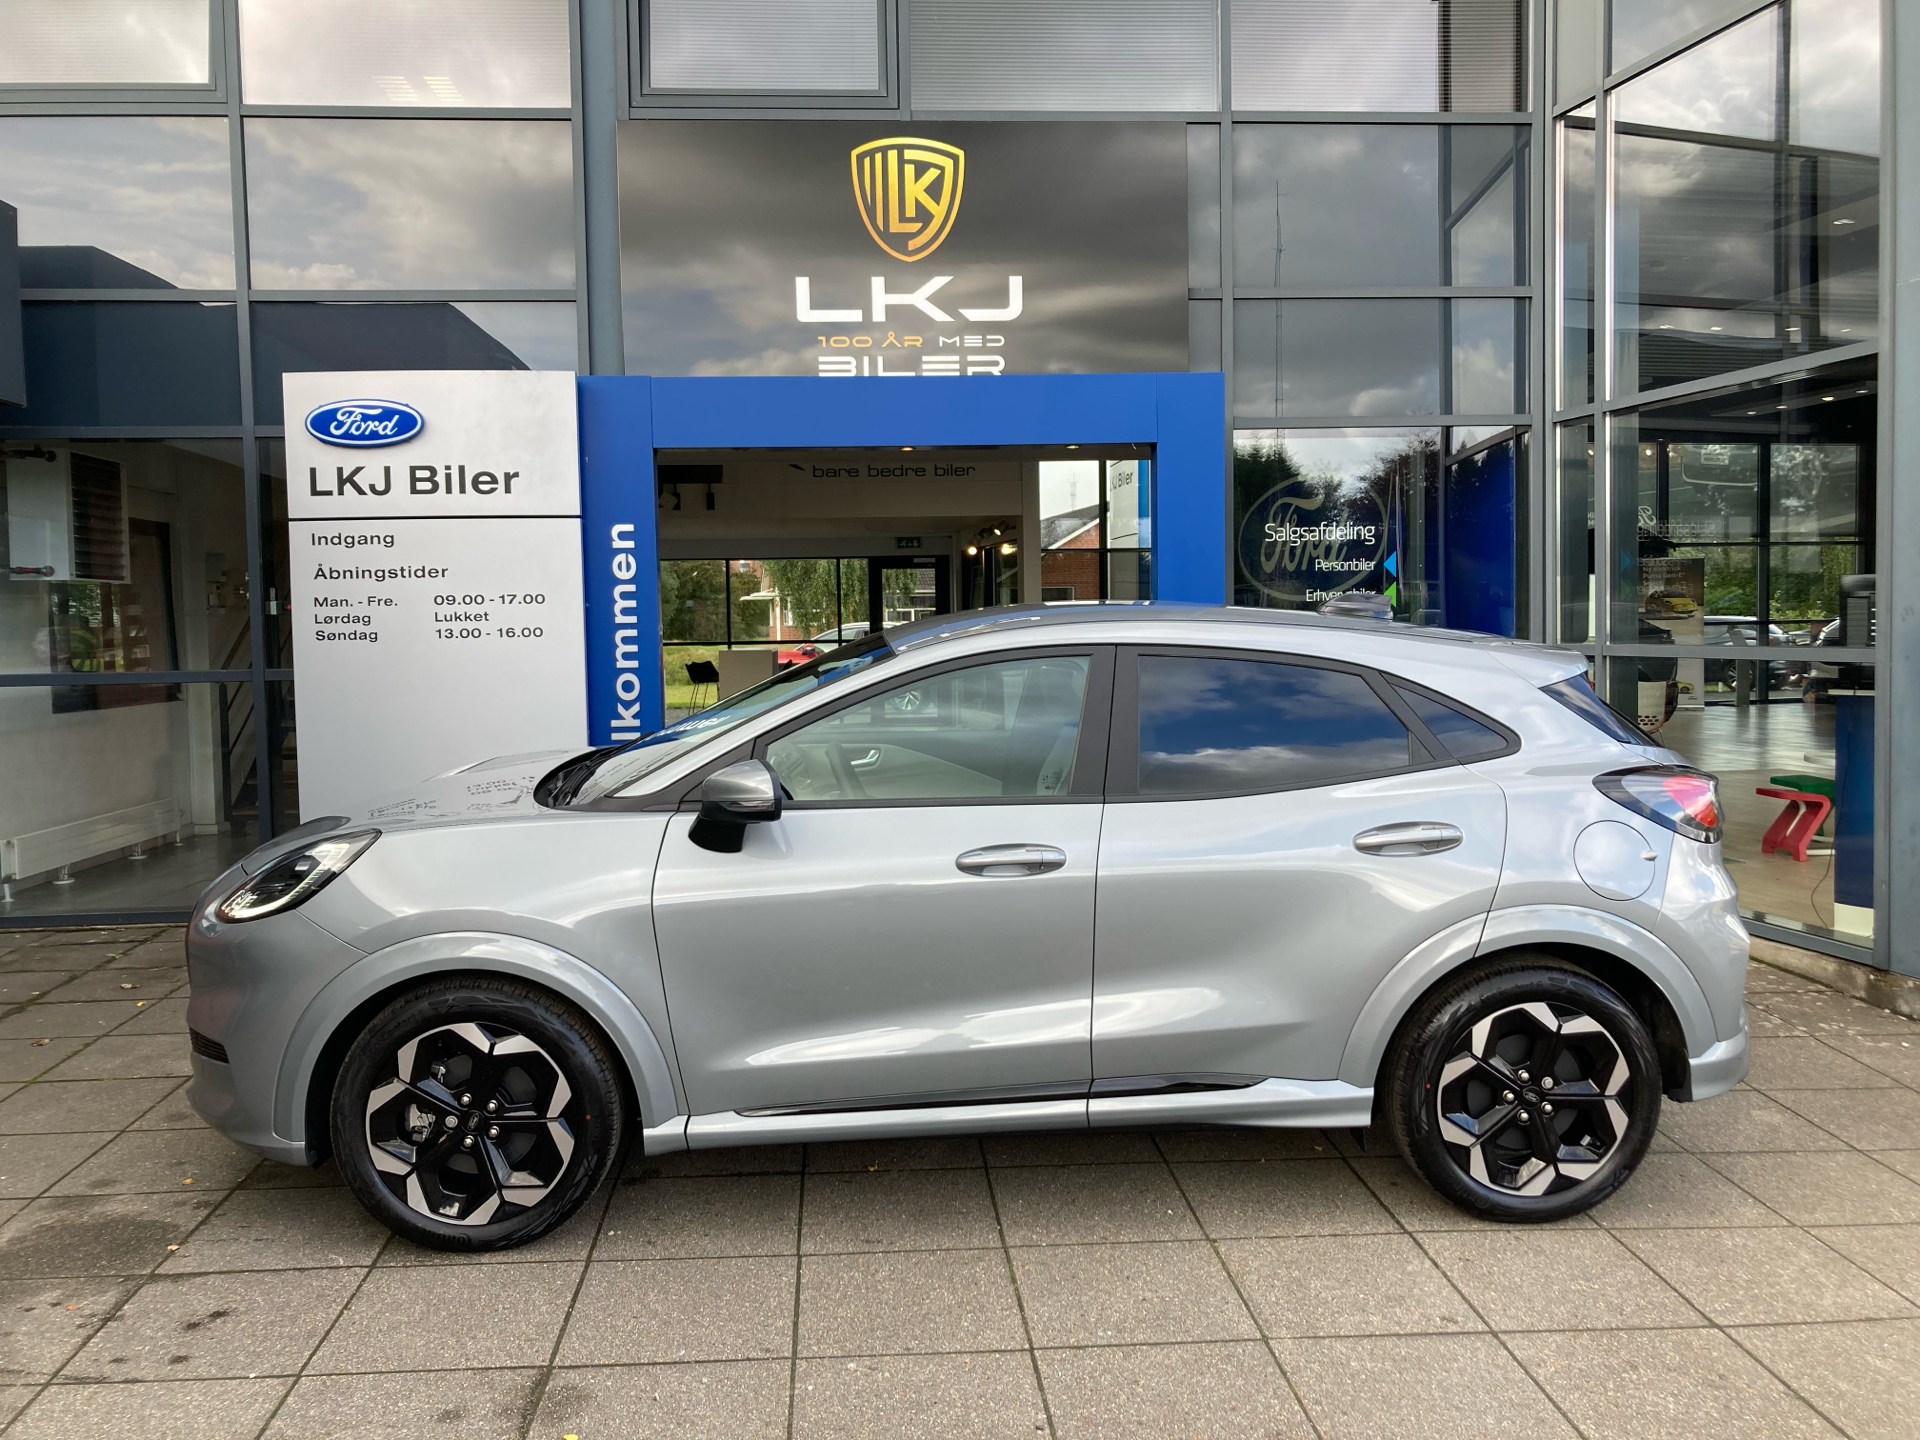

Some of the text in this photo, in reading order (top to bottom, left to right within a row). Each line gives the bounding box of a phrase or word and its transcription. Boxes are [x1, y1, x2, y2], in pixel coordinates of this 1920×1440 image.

[795, 275, 1023, 323] LKJ
[817, 331, 1005, 348] 100 ÅR MED
[818, 355, 1006, 377] BILER
[329, 406, 400, 437] Ford
[812, 463, 976, 478] bare bedre biler
[309, 464, 520, 497] LKJ Biler
[311, 532, 395, 549] Indgang
[1264, 521, 1376, 547] Salgsafdeling
[313, 563, 449, 582] Åbningstider
[1315, 557, 1377, 572] Personbiler
[313, 596, 354, 608] Man.
[367, 595, 398, 607] Fre.
[433, 594, 485, 606] 09.00
[498, 593, 546, 605] 17.00
[314, 611, 490, 627] Lørdag Lukket
[315, 629, 378, 643] Søndag
[435, 628, 482, 639] 13.00
[496, 627, 544, 638] 16.00
[610, 523, 641, 741] lkommen
